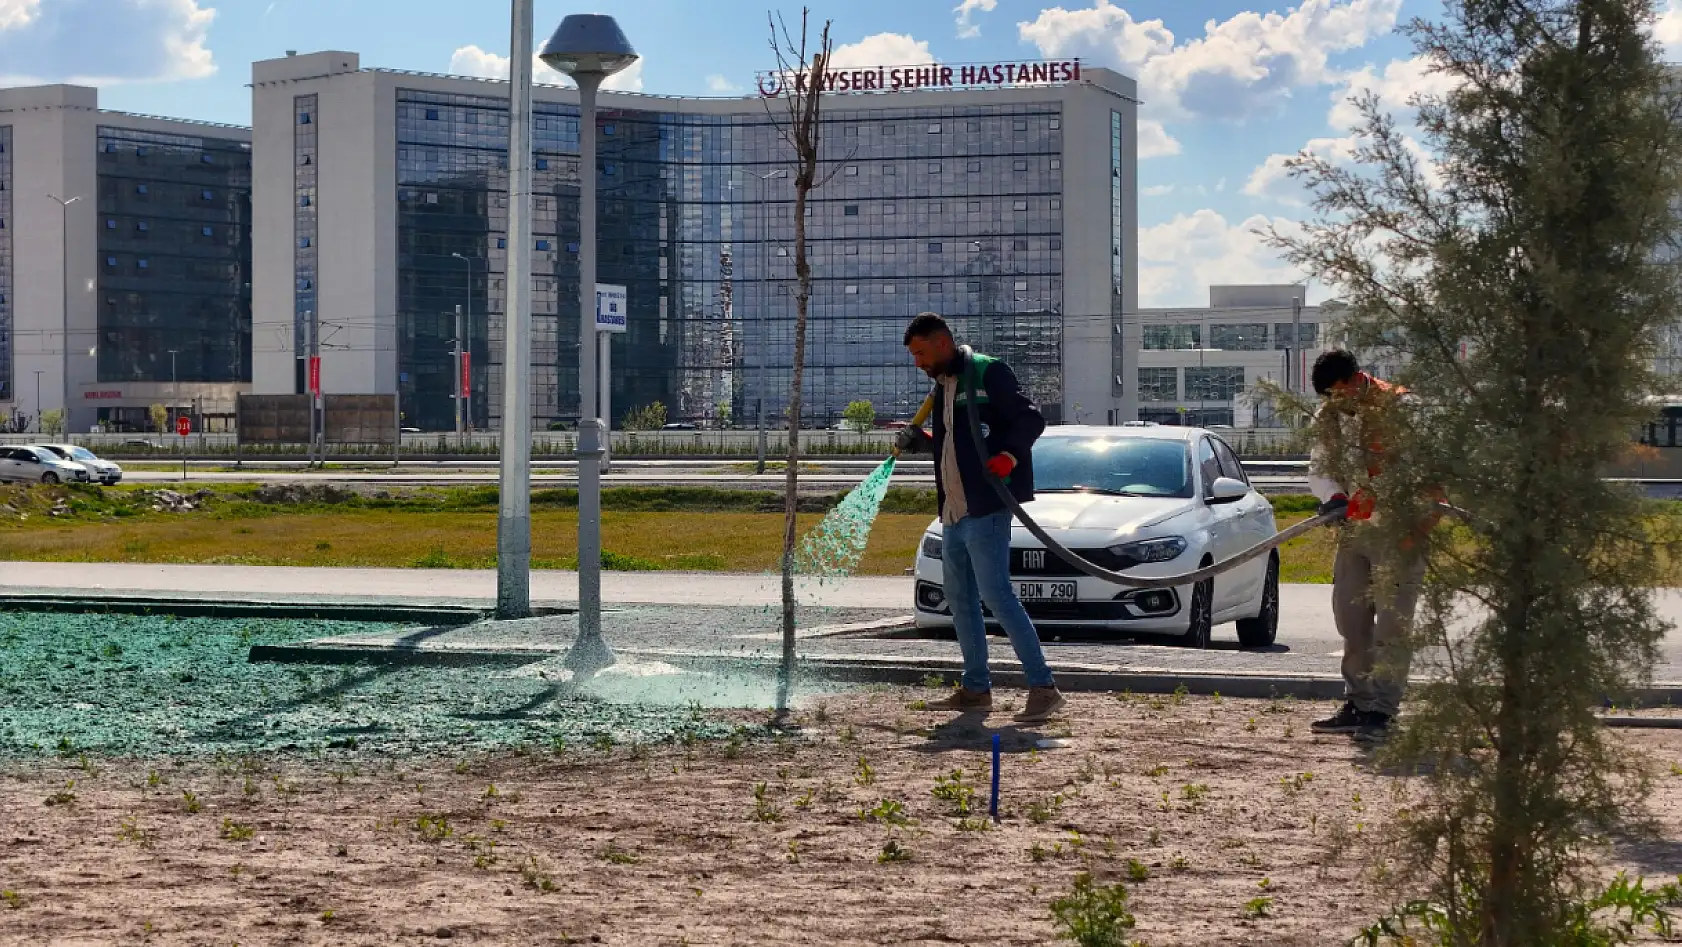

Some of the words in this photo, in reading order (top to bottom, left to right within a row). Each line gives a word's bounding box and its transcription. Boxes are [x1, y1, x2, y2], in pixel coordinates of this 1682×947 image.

[891, 63, 953, 92] ŞEHİR
[961, 57, 1080, 85] HASTANESİ
[1022, 550, 1046, 569] FIAT
[1020, 583, 1043, 598] BDN
[1050, 583, 1074, 598] 290
